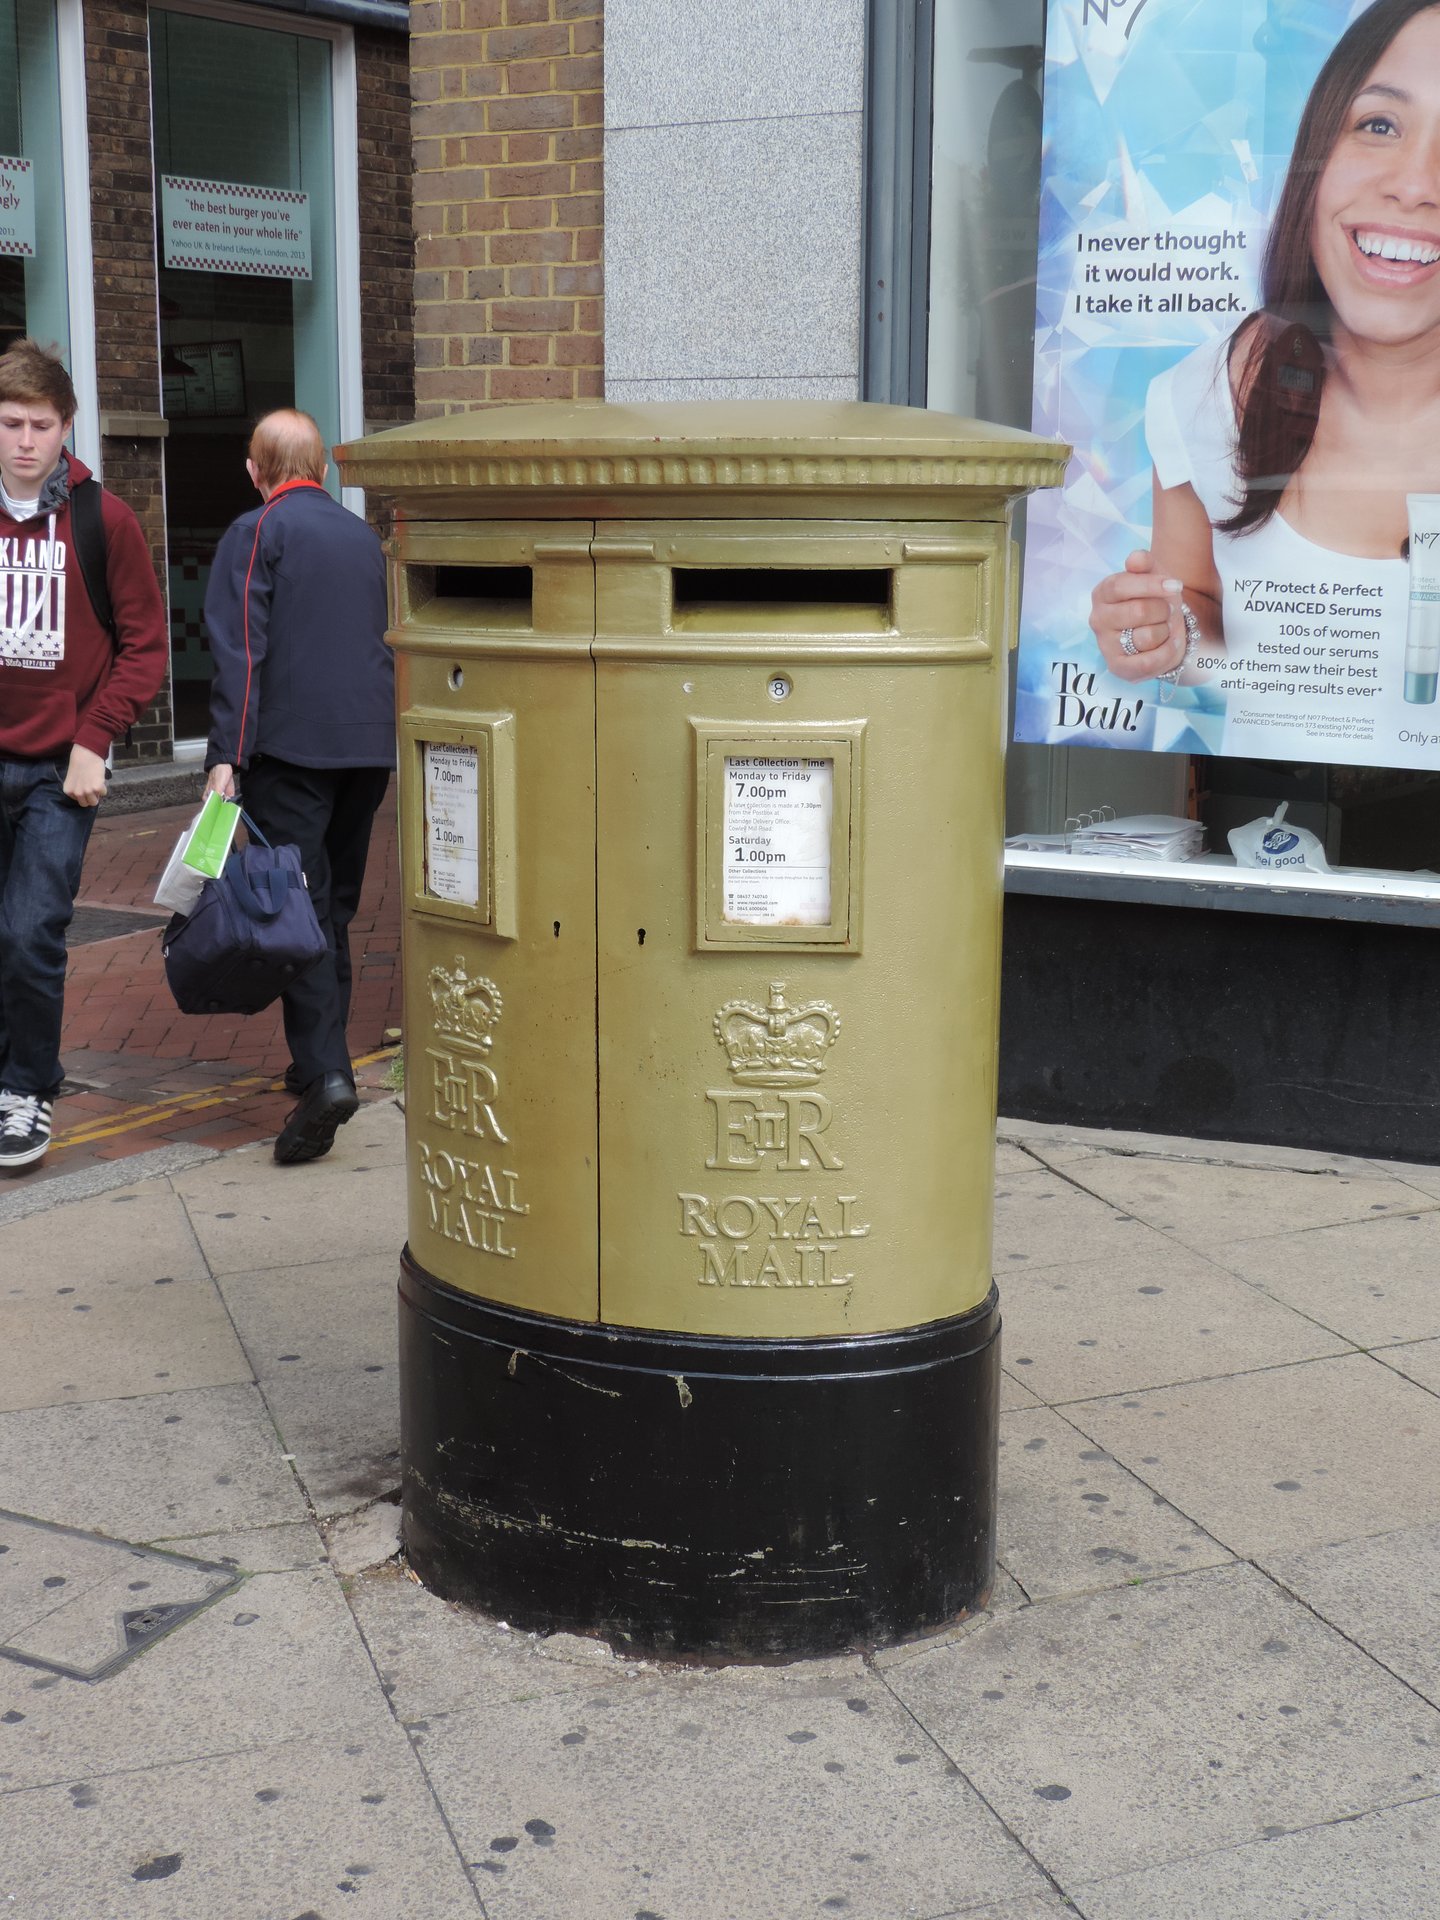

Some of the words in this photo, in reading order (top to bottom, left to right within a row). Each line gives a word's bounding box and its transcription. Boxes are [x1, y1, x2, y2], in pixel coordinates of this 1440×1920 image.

[0, 174, 15, 191] ly,
[0, 193, 20, 210] gly
[207, 201, 226, 214] best
[229, 204, 258, 220] burger
[261, 209, 290, 222] you've
[172, 220, 192, 230] ever
[195, 221, 220, 233] eaten
[222, 222, 231, 234] in
[233, 226, 254, 238] your
[256, 227, 283, 239] whole
[171, 239, 193, 249] Yahoo
[193, 242, 203, 250] UK
[212, 243, 234, 253] Ireland
[290, 251, 305, 259] 2013
[1078, 233, 1083, 252] I
[1088, 237, 1150, 252] never
[1154, 229, 1247, 255] thought
[1085, 264, 1100, 283] it
[1105, 262, 1171, 282] would
[1176, 261, 1239, 281] work.
[1076, 295, 1081, 313] I
[1086, 294, 1133, 313] take
[1138, 294, 1153, 313] it
[1157, 293, 1182, 312] all
[1188, 293, 1247, 312] back.
[1265, 581, 1316, 594] Protect
[1319, 583, 1329, 595] &
[1332, 584, 1383, 597] Perfect
[1244, 600, 1326, 615] ADVANCED
[1328, 604, 1382, 618] Serums
[1279, 624, 1310, 637] 100s
[1313, 626, 1328, 637] of
[1329, 629, 1380, 640] women
[1257, 642, 1300, 655] tested
[1303, 646, 1326, 656] our
[1329, 647, 1379, 659] serums
[1196, 657, 1227, 670] 80%
[1230, 659, 1246, 671] of
[1246, 660, 1281, 673] them
[1284, 664, 1310, 675] saw
[1313, 663, 1345, 676] their
[1347, 665, 1378, 678] best
[1052, 662, 1099, 696] Ta
[1220, 678, 1295, 695] anti-ageing
[1298, 682, 1344, 696] results
[773, 682, 785, 696] 8
[1052, 695, 1144, 732] Dah!
[1276, 712, 1298, 721] testing
[1321, 715, 1346, 723] Protect
[1351, 717, 1375, 725] Perfect
[1232, 718, 1270, 726] ADVANCED
[1271, 720, 1295, 728] Serums
[1317, 723, 1342, 731] existing
[1356, 725, 1374, 733] users
[1342, 731, 1352, 739] for
[1398, 730, 1429, 746] Only
[1430, 735, 1440, 744] a
[429, 743, 441, 752] Last
[442, 744, 469, 754] Collection
[430, 756, 450, 767] Monday
[459, 758, 476, 770] Friday
[729, 758, 750, 767] Last
[753, 758, 799, 767] Collection
[801, 759, 825, 767] Time
[434, 767, 463, 784] 7.00pm
[729, 771, 766, 782] Monday
[769, 772, 779, 780] to
[782, 772, 811, 782] Friday
[735, 783, 787, 800] 7.00pm
[431, 816, 455, 827] Saturday
[435, 827, 464, 845] 1.00pm
[728, 836, 771, 846] Saturday
[735, 847, 786, 864] 1.00pm
[1275, 853, 1305, 868] good
[417, 1140, 530, 1215] ROYAL
[427, 1188, 516, 1259] MAIL
[678, 1193, 872, 1240] ROYAL
[698, 1242, 855, 1288] MAIL
